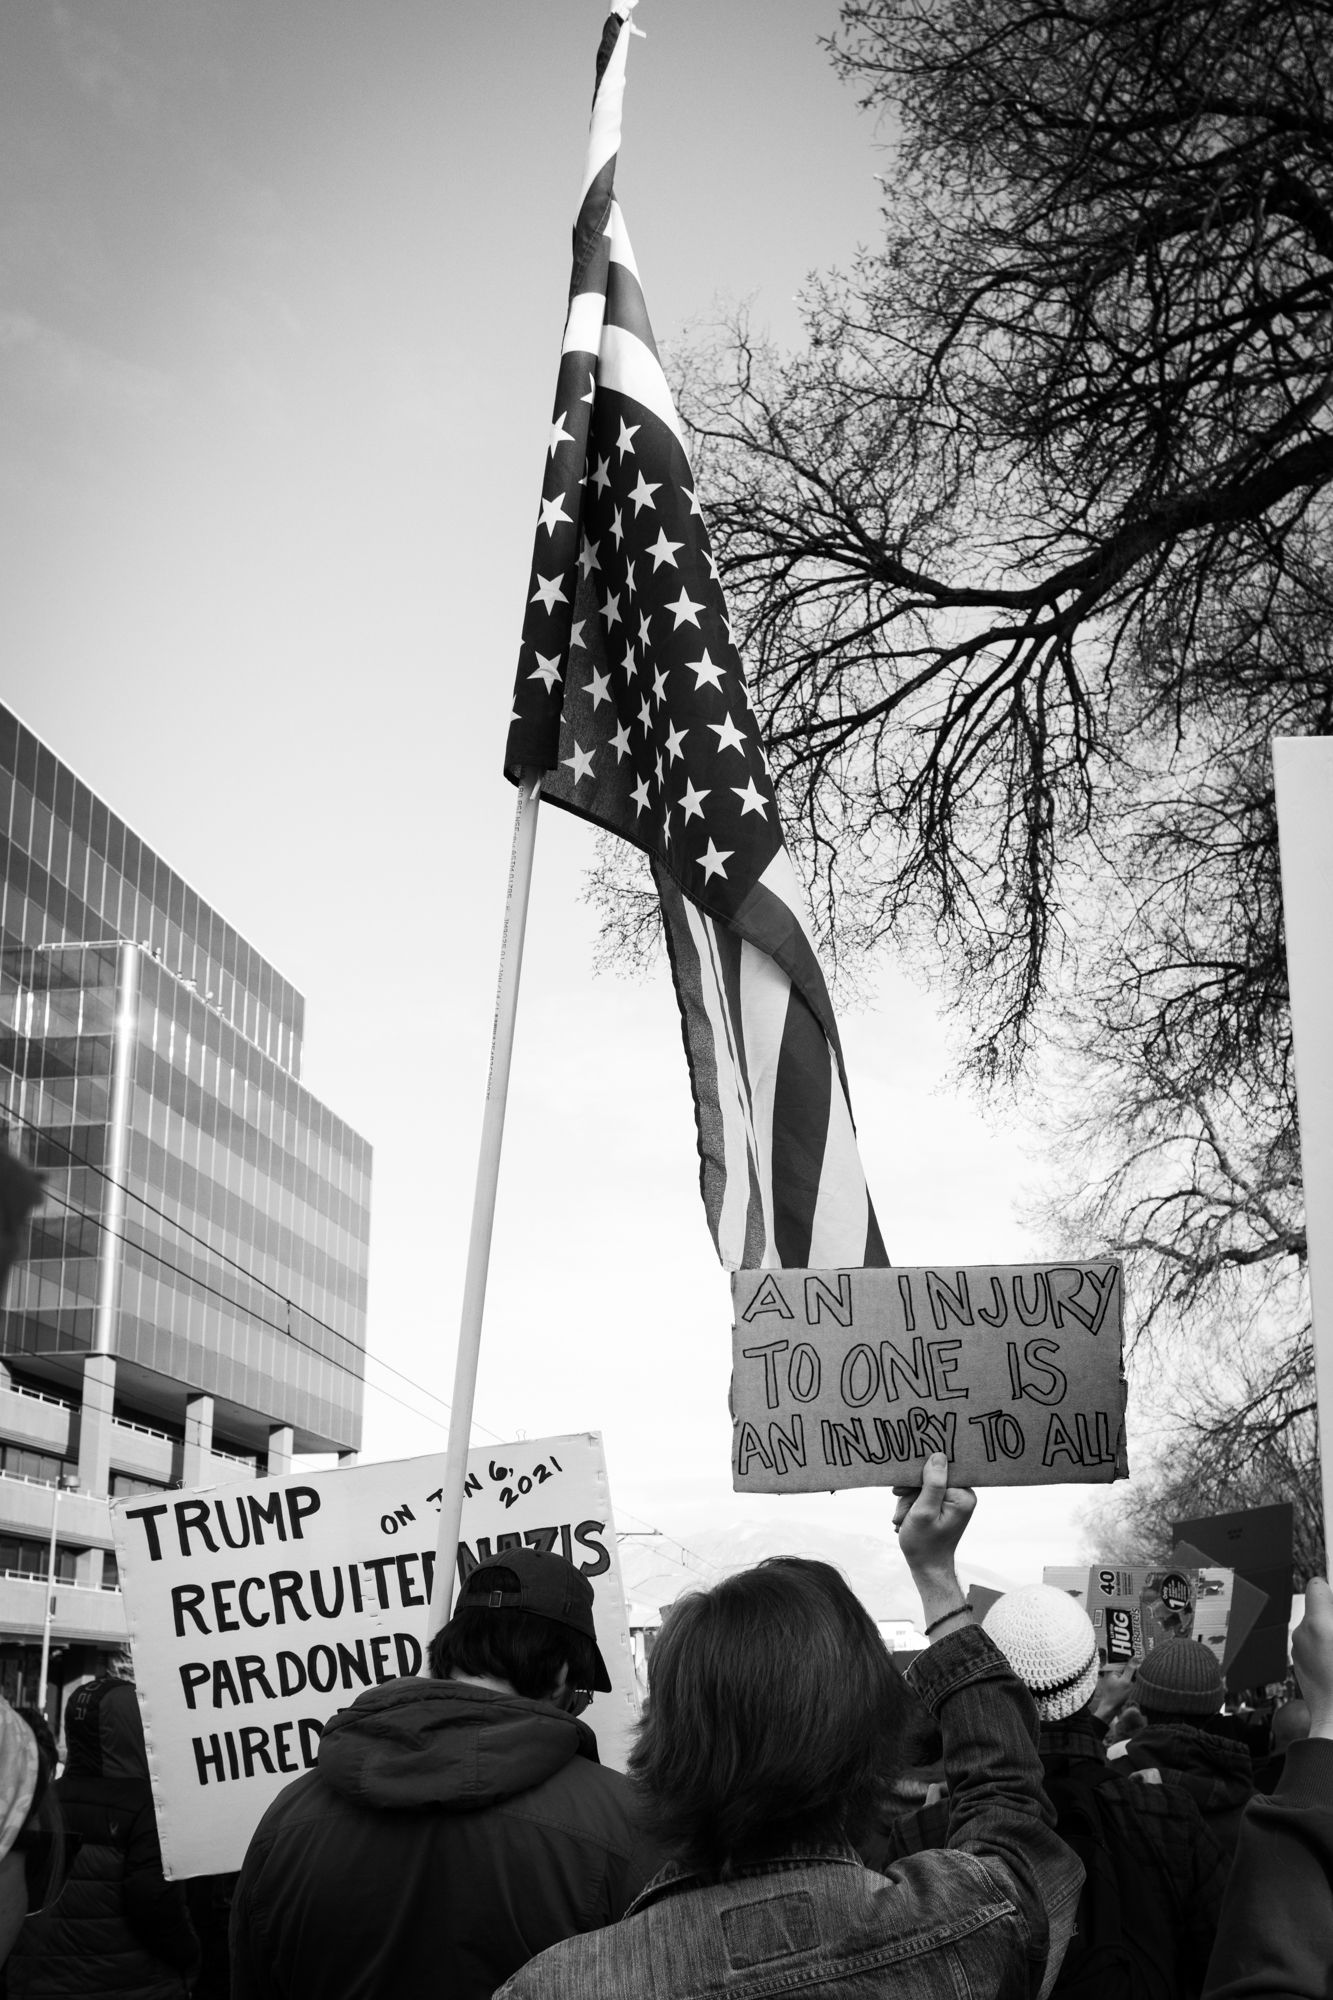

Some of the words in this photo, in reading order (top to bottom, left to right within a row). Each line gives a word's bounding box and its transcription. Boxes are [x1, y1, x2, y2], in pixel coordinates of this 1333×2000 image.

[742, 1273, 852, 1326] AN
[899, 1265, 1118, 1335] INJURY
[743, 1340, 820, 1409] TO
[841, 1337, 968, 1407] ONE
[1007, 1339, 1067, 1405] IS
[738, 1414, 806, 1475] AN
[820, 1407, 956, 1466] INJURY
[970, 1410, 1025, 1462] TO
[1042, 1412, 1115, 1466] ALL
[380, 1504, 416, 1535] ON
[426, 1472, 483, 1512] JN
[499, 1456, 563, 1509] 2021
[126, 1486, 321, 1561] TRUMP
[456, 1520, 611, 1588] NIS
[1100, 1570, 1116, 1596] 40
[1112, 1612, 1131, 1656] HUG
[179, 1633, 423, 1709] PARDONED
[192, 1718, 324, 1785] HIRED
